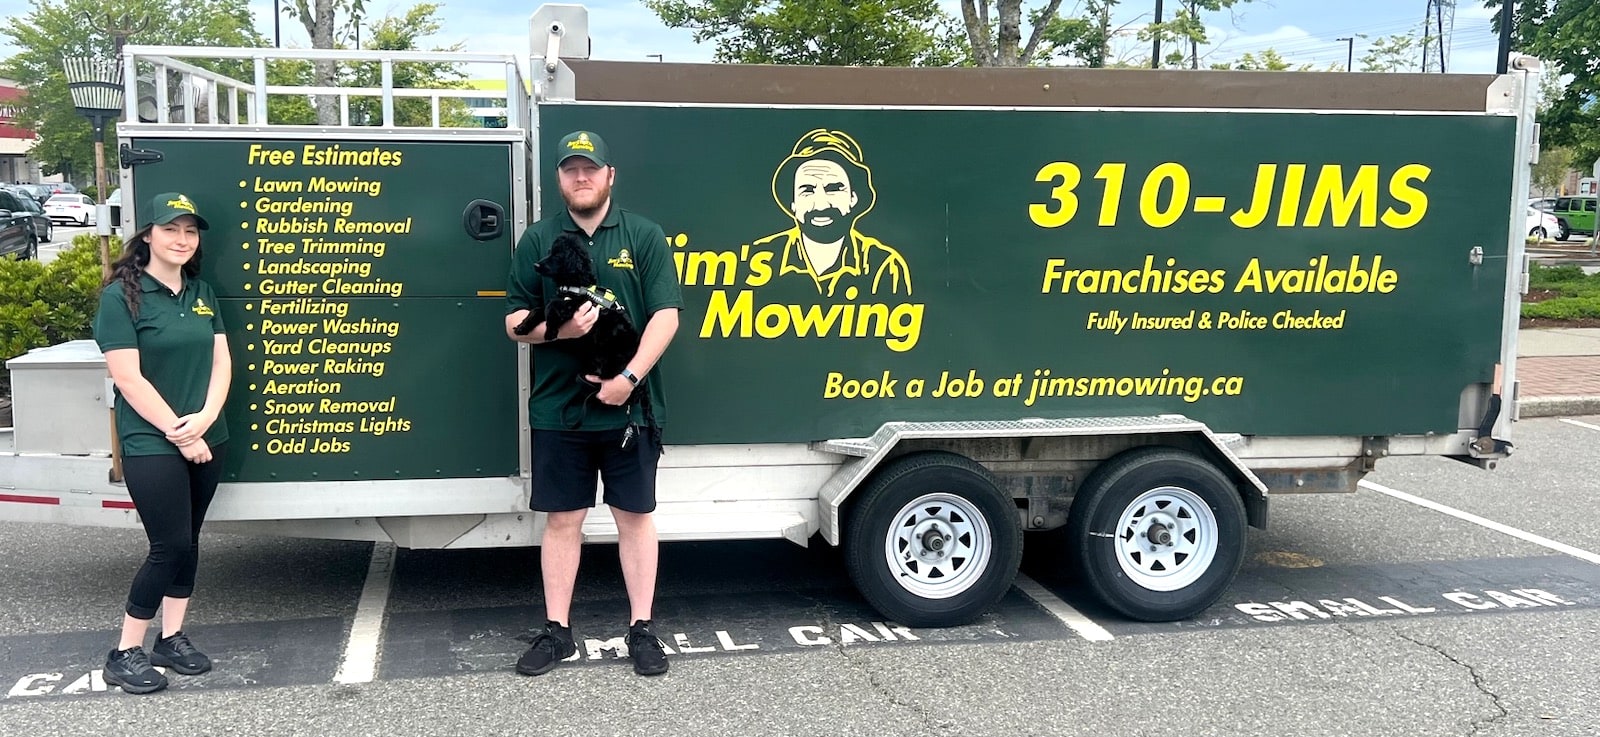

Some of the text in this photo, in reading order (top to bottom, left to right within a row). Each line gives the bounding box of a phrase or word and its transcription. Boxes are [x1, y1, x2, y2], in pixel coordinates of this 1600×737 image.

[248, 144, 402, 167] Free Estimates
[253, 177, 382, 197] Lawn Mowing
[1028, 161, 1433, 230] 310-JIMS
[255, 197, 353, 216] Gardening
[255, 217, 412, 235] Rubbish Removal
[257, 238, 386, 256] Tree Trimming
[257, 259, 372, 278] Landscaping
[666, 233, 775, 288] im's
[1041, 254, 1399, 295] Franchises Available
[259, 278, 403, 297] Gutter Cleaning
[260, 299, 349, 318] Fertilizing
[260, 318, 400, 337] Power Washing
[699, 286, 926, 353] Mowing
[1086, 309, 1347, 335] Fully Insured & Police Checked
[262, 338, 393, 357] Yard Cleanups
[262, 358, 385, 377] Power Raking
[262, 379, 342, 395] Aeration
[823, 368, 1244, 407] Book a Job at jimsmowing.ca
[264, 397, 396, 415] Snow Removal
[265, 416, 412, 435] Christmas Lights
[266, 437, 351, 455] Odd Jobs
[1234, 588, 1576, 622] SMALL CAR
[7, 665, 166, 698] CA
